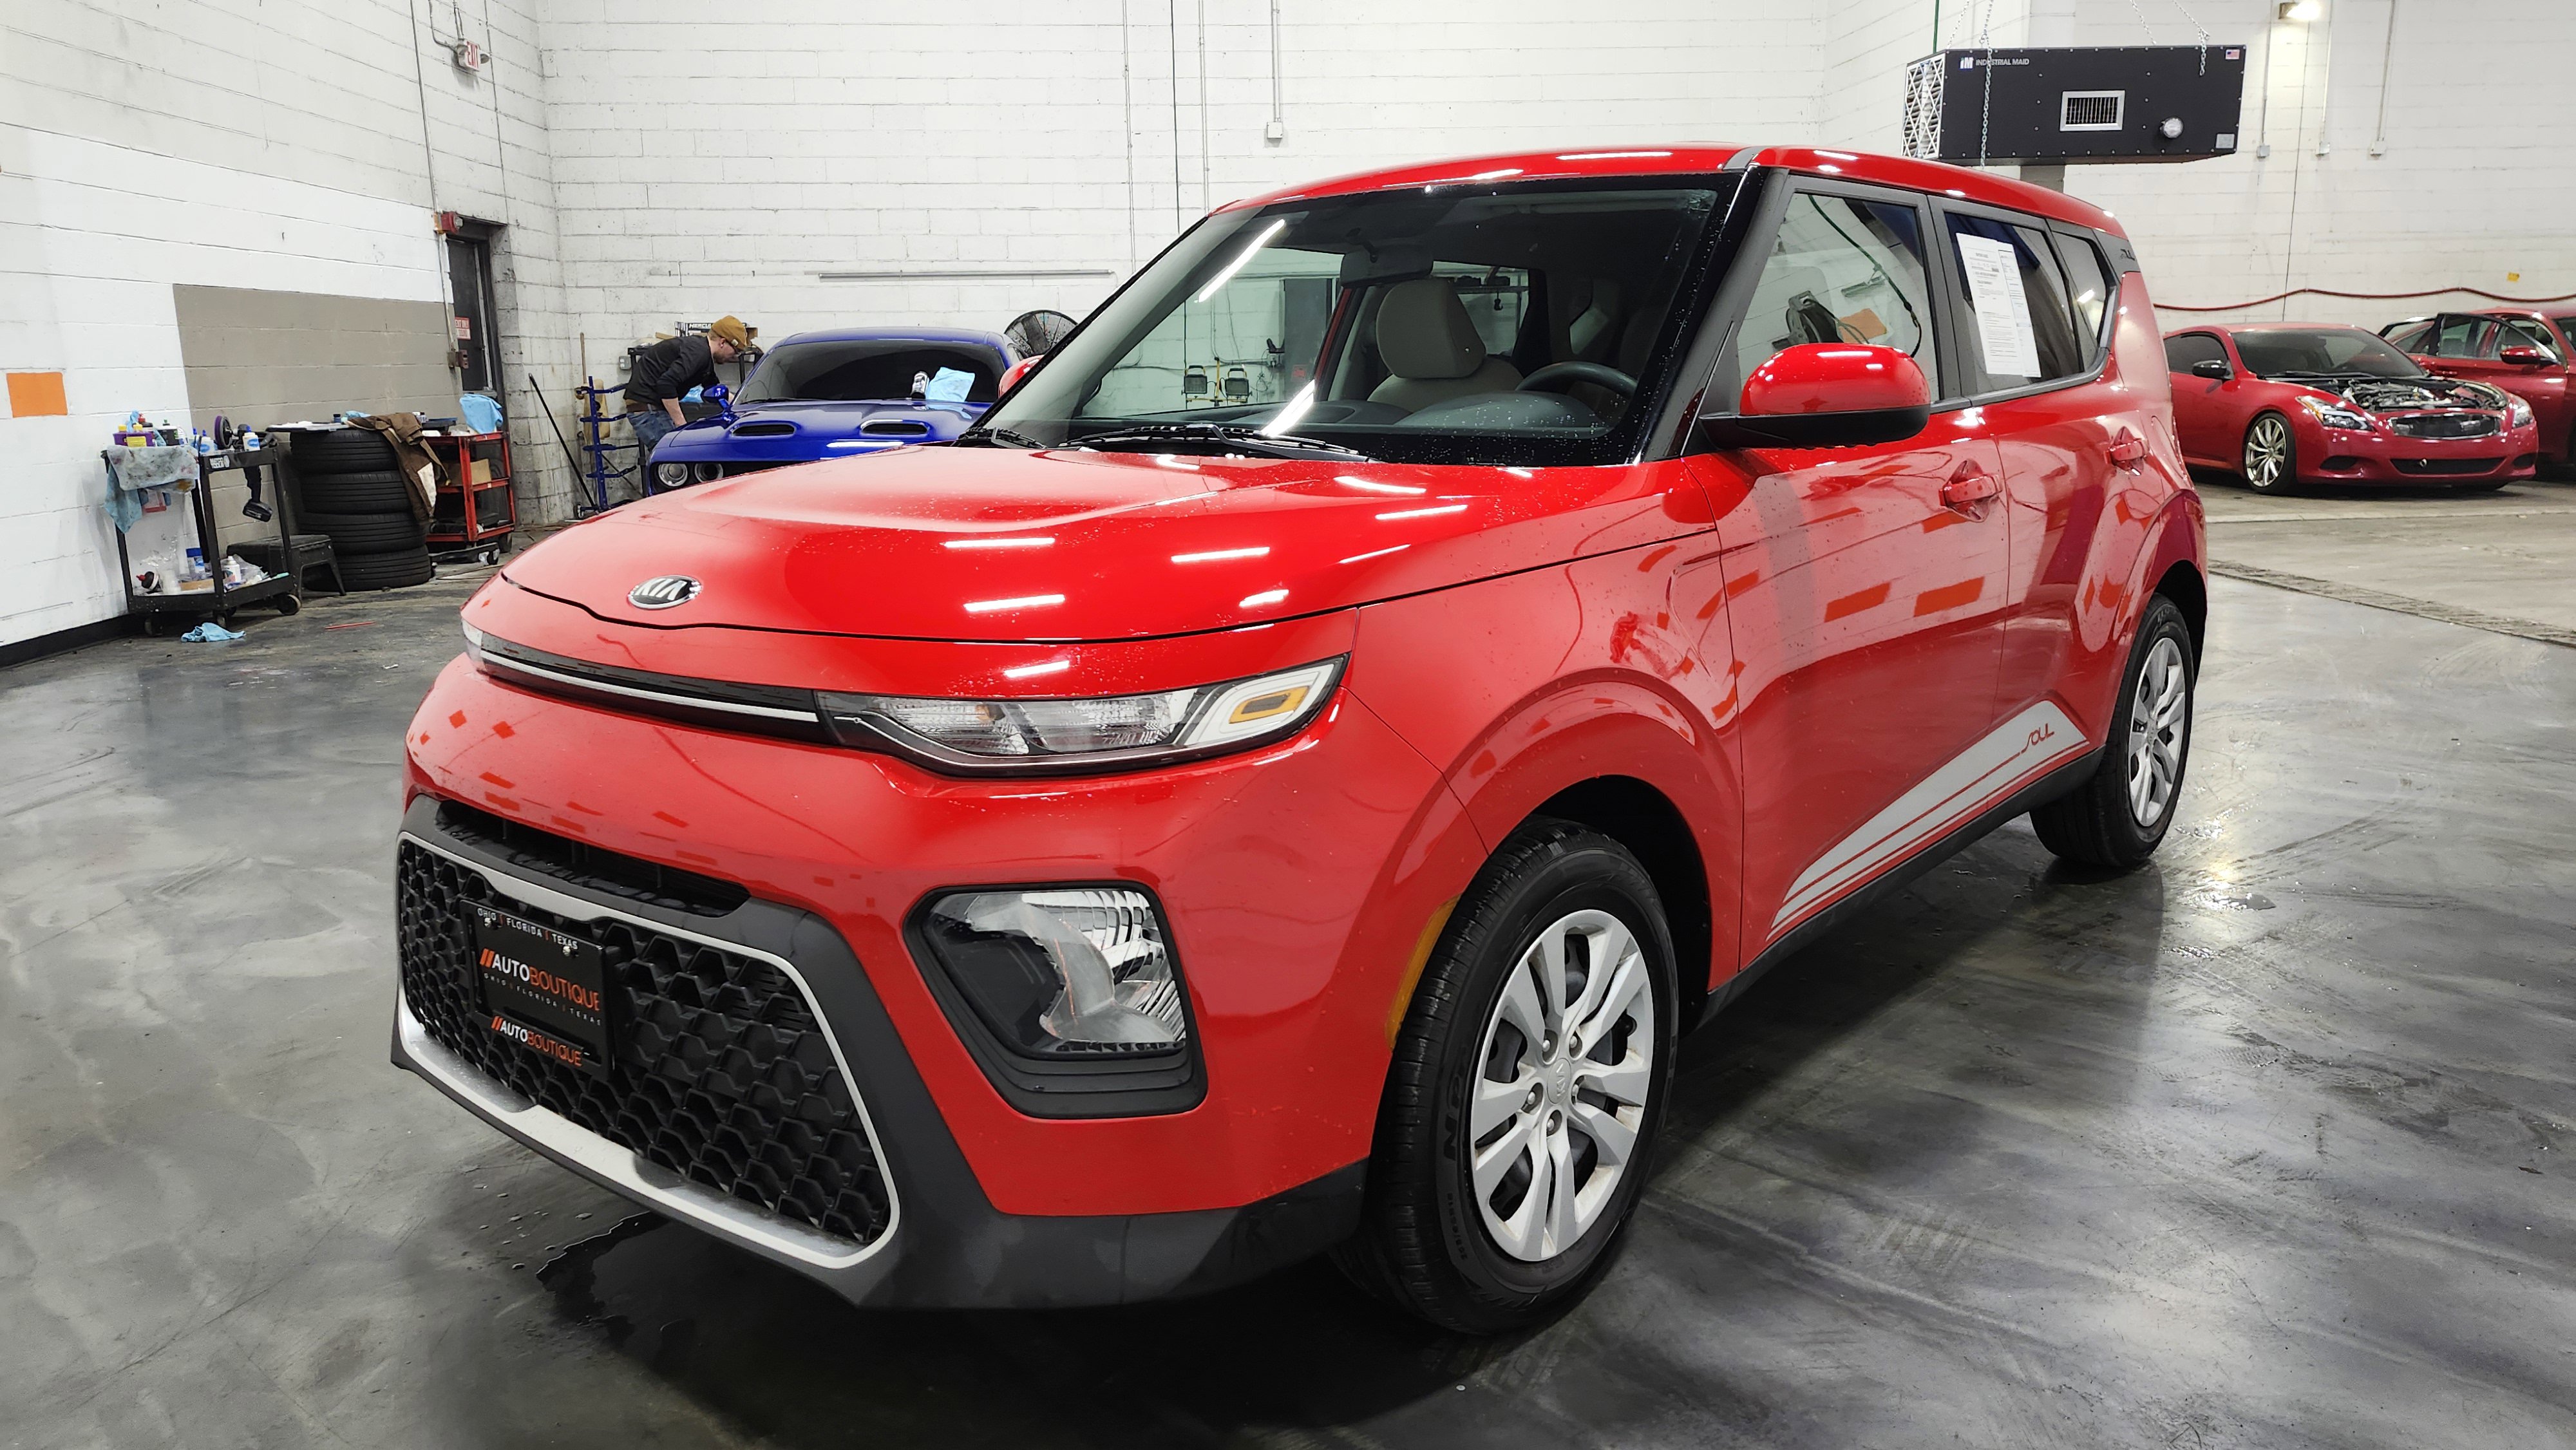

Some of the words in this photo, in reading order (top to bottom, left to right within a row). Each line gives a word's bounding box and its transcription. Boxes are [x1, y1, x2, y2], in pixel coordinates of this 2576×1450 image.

[465, 41, 479, 68] EXIT
[634, 578, 688, 601] KIA
[2021, 722, 2055, 754] SOUL
[477, 908, 497, 921] OHIO
[506, 918, 542, 937] FLORIDA
[552, 933, 578, 950] TEXAS
[516, 986, 557, 1007] FLORIDA
[569, 1008, 601, 1026] TEXAS
